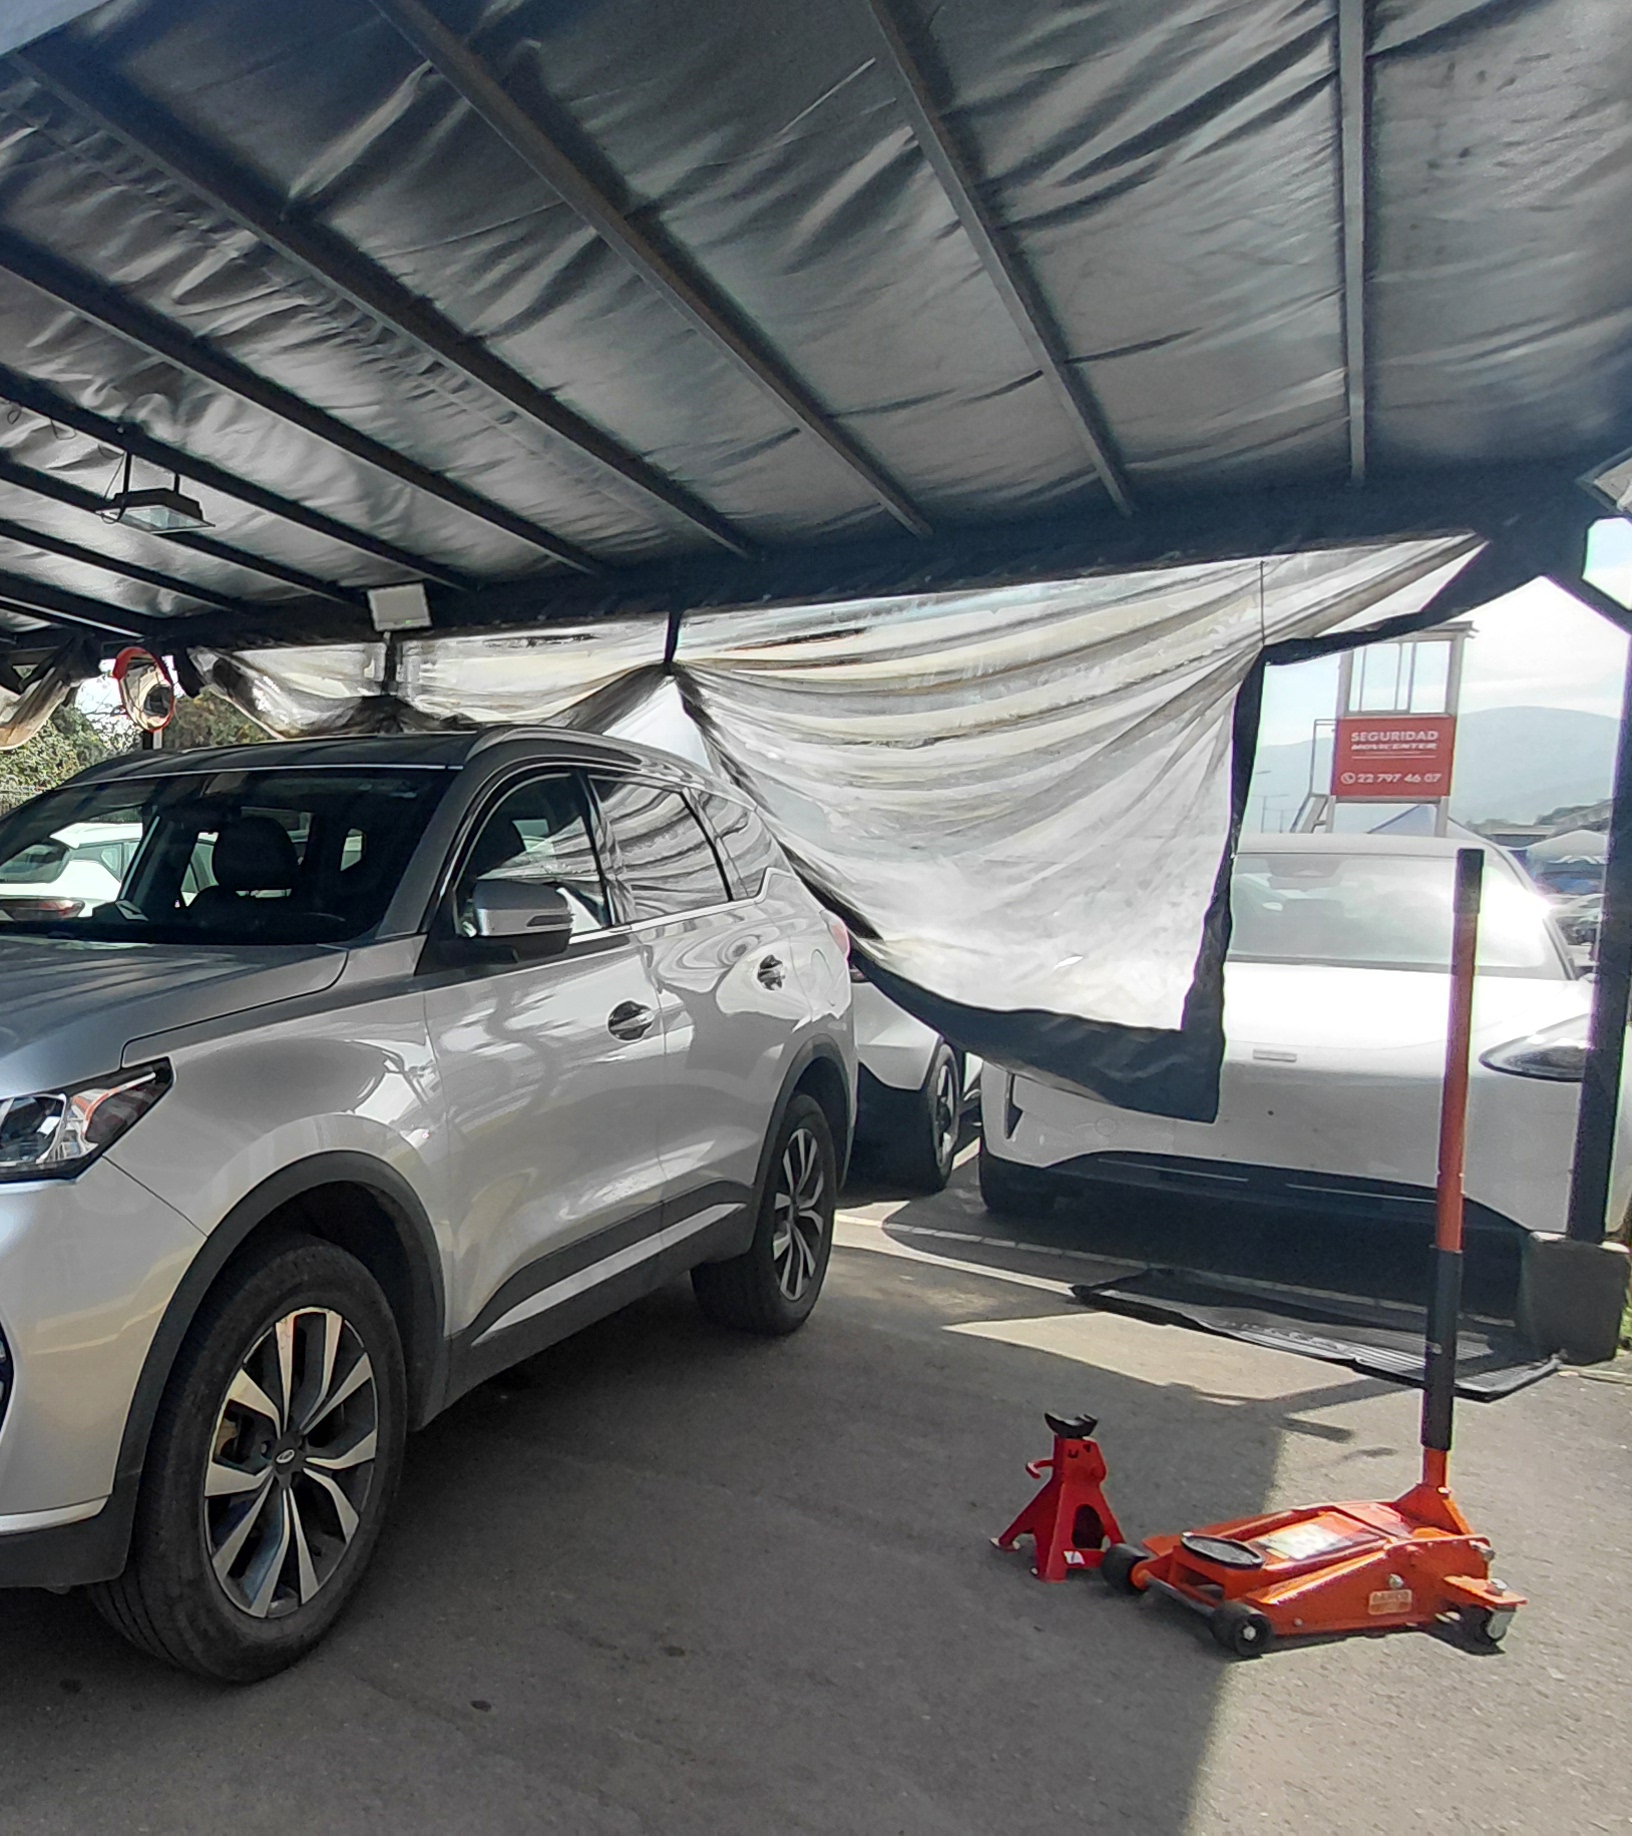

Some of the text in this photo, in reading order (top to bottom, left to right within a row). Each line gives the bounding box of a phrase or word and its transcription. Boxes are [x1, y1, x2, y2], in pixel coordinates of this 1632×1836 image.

[1351, 731, 1439, 742] SEGURIDAD
[1357, 773, 1442, 783] 22 797 46 07
